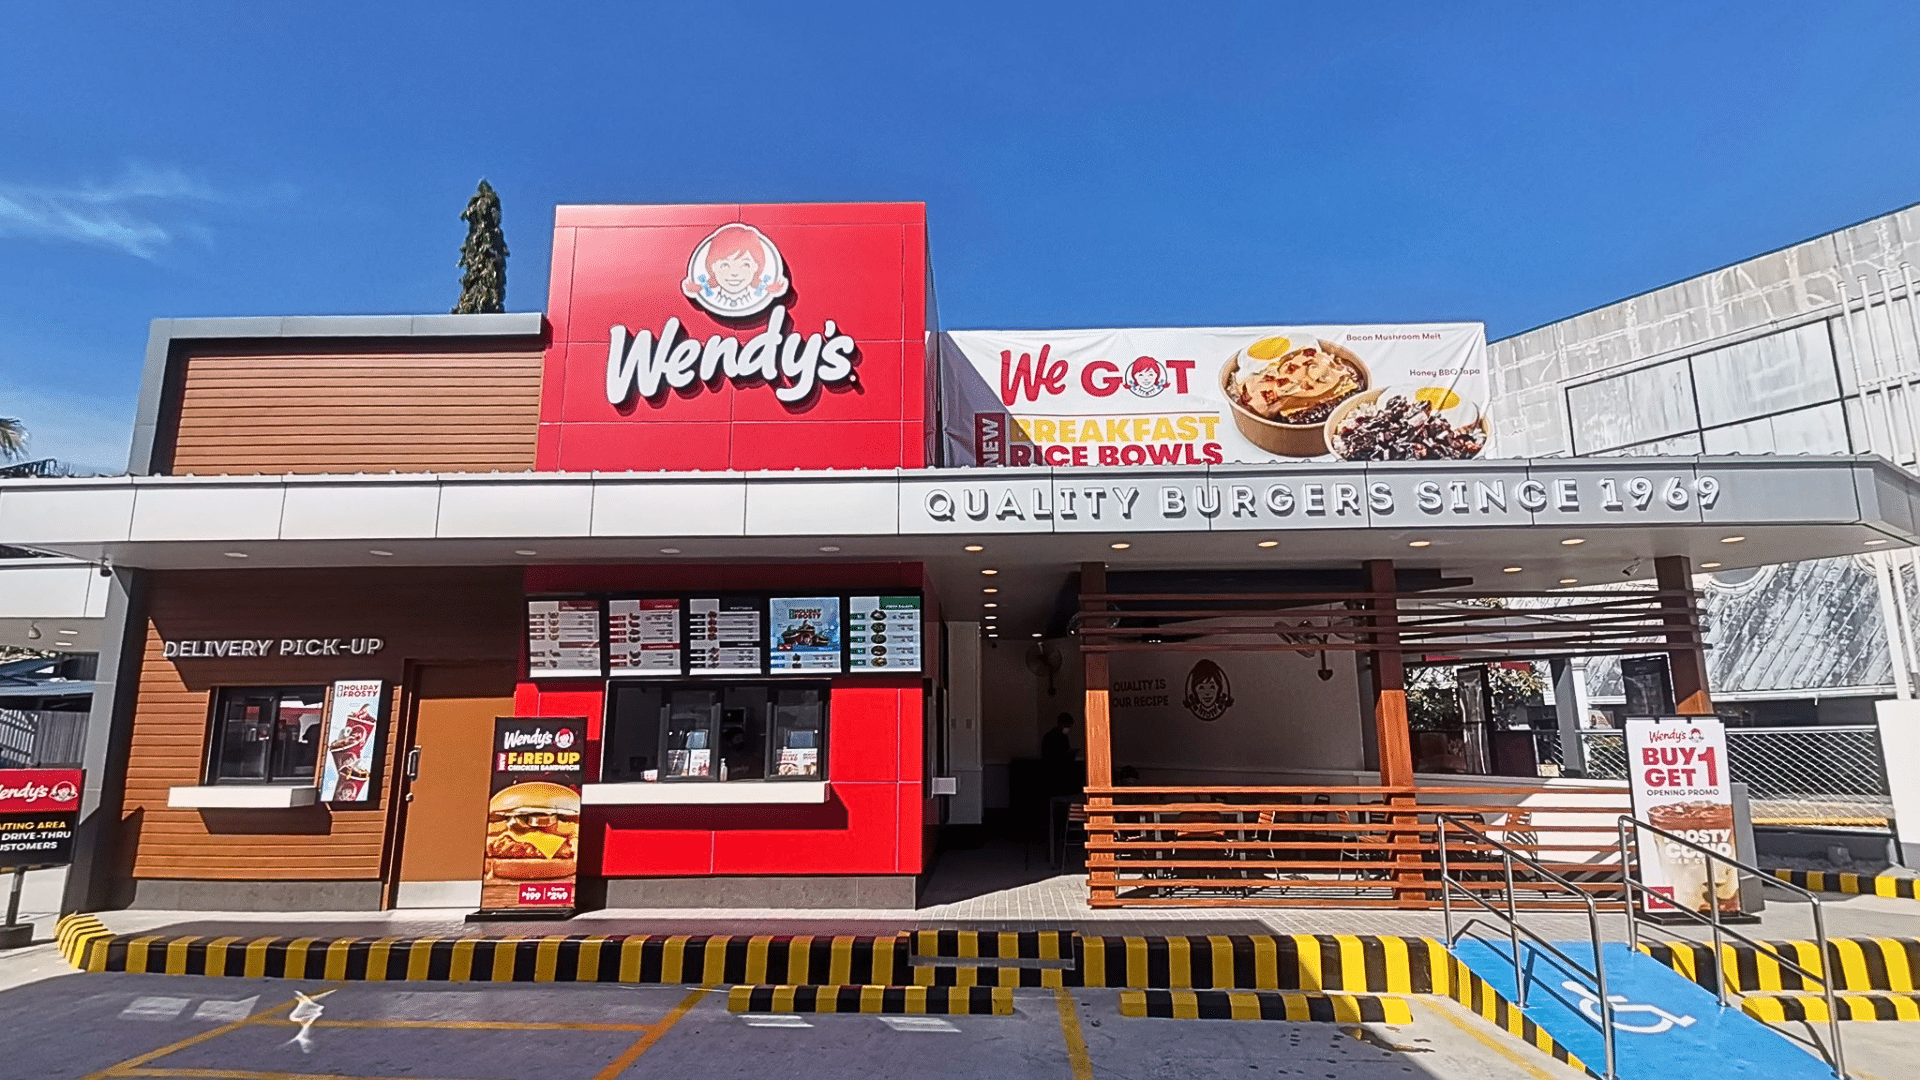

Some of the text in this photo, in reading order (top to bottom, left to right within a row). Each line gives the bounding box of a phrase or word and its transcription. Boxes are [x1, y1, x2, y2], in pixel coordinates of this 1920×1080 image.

[1375, 333, 1420, 341] Mushroom
[606, 305, 854, 404] Wendy's
[1000, 344, 1068, 406] We
[1409, 369, 1437, 378] Honey
[1438, 368, 1458, 377] BBQ
[1010, 416, 1220, 443] BREAKFAST
[983, 418, 999, 467] NEW
[1010, 443, 1223, 467] RICE BOWLS
[924, 476, 1720, 521] QUALITY BURGERS SINCE 1969
[162, 638, 384, 657] DELIVERY PICK-UP
[1113, 679, 1166, 691] QUALITY IS
[1112, 695, 1169, 707] OUR RECIPE
[503, 727, 553, 750] Wendy's
[1649, 728, 1687, 743] Wendy's
[557, 752, 580, 765] UP
[1641, 746, 1718, 786] BUY 1
[1644, 768, 1697, 788] GET
[1646, 789, 1686, 797] OPENING
[37, 821, 67, 829] AREA
[1, 831, 72, 840] DRIVE-THRU
